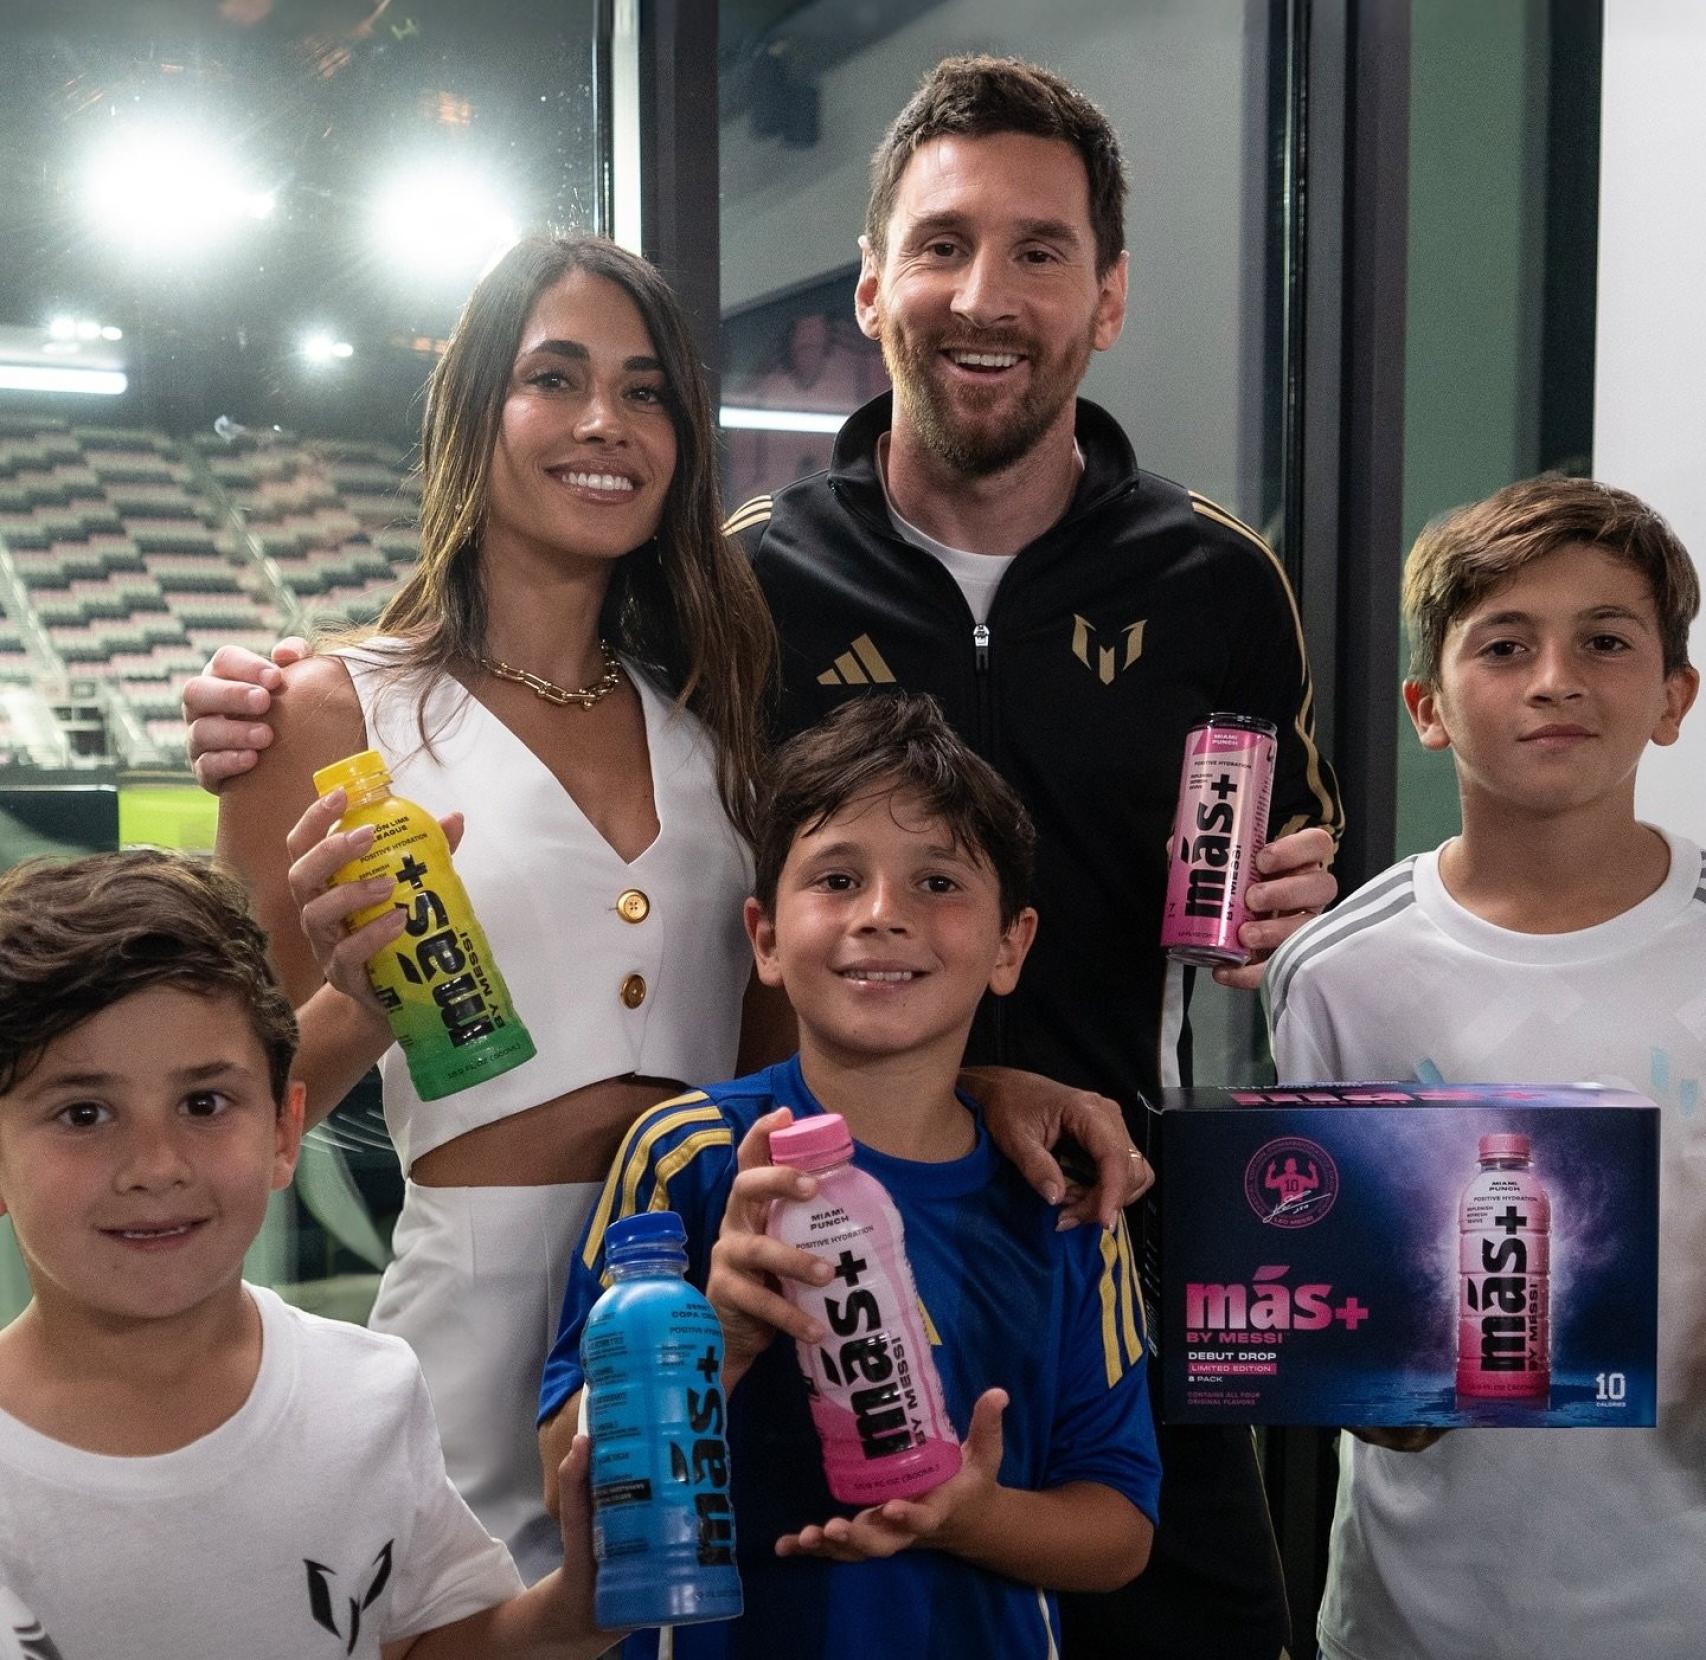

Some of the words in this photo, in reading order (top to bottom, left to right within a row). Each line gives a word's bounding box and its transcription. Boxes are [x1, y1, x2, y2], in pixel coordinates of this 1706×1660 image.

[390, 816, 410, 827] LIME
[360, 846, 392, 863] POSITIVE
[392, 832, 428, 849] HYDRATION
[1230, 844, 1241, 896] MESSI
[459, 929, 493, 998] MESSI
[490, 1002, 506, 1029] BY
[1287, 1179, 1299, 1192] 10
[810, 1215, 849, 1231] PUNCH
[811, 1207, 844, 1222] MIAMI
[795, 1239, 830, 1249] POSITIVE
[831, 1225, 874, 1243] HYDRATION
[1186, 1265, 1369, 1331] más+
[1528, 1283, 1539, 1342] MESSI
[1186, 1332, 1213, 1344] BY
[1219, 1332, 1283, 1344] MESSI
[1188, 1352, 1234, 1361] DEBUT
[1238, 1352, 1277, 1361] DROP
[1528, 1351, 1539, 1371] BY
[892, 1337, 918, 1411] MESSI
[1595, 1372, 1626, 1400] 10
[910, 1421, 927, 1447] BY
